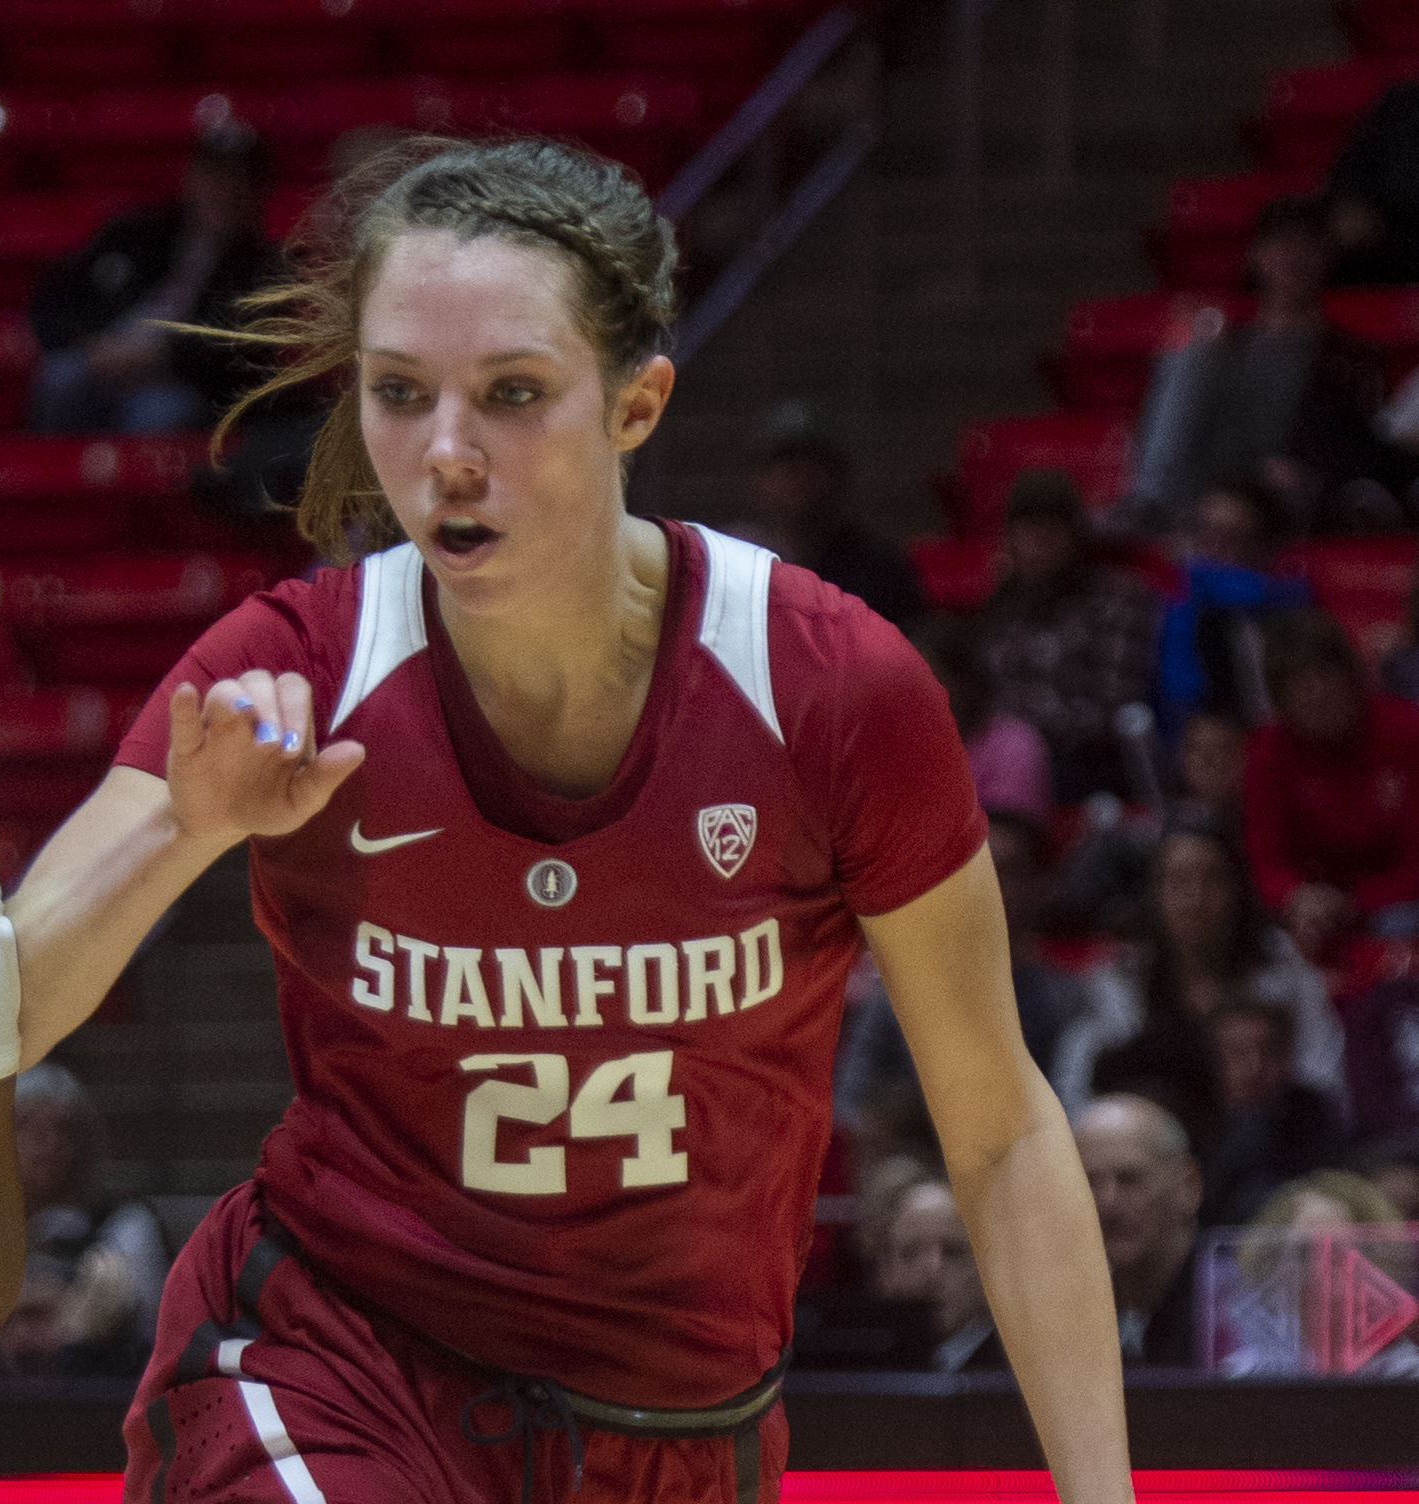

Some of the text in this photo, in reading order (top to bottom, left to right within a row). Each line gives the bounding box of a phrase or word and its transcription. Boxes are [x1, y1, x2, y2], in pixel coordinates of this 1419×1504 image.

[703, 808, 753, 849] PAC
[714, 834, 741, 861] 12
[350, 917, 784, 1029] STANFORD
[459, 1050, 689, 1195] 24
